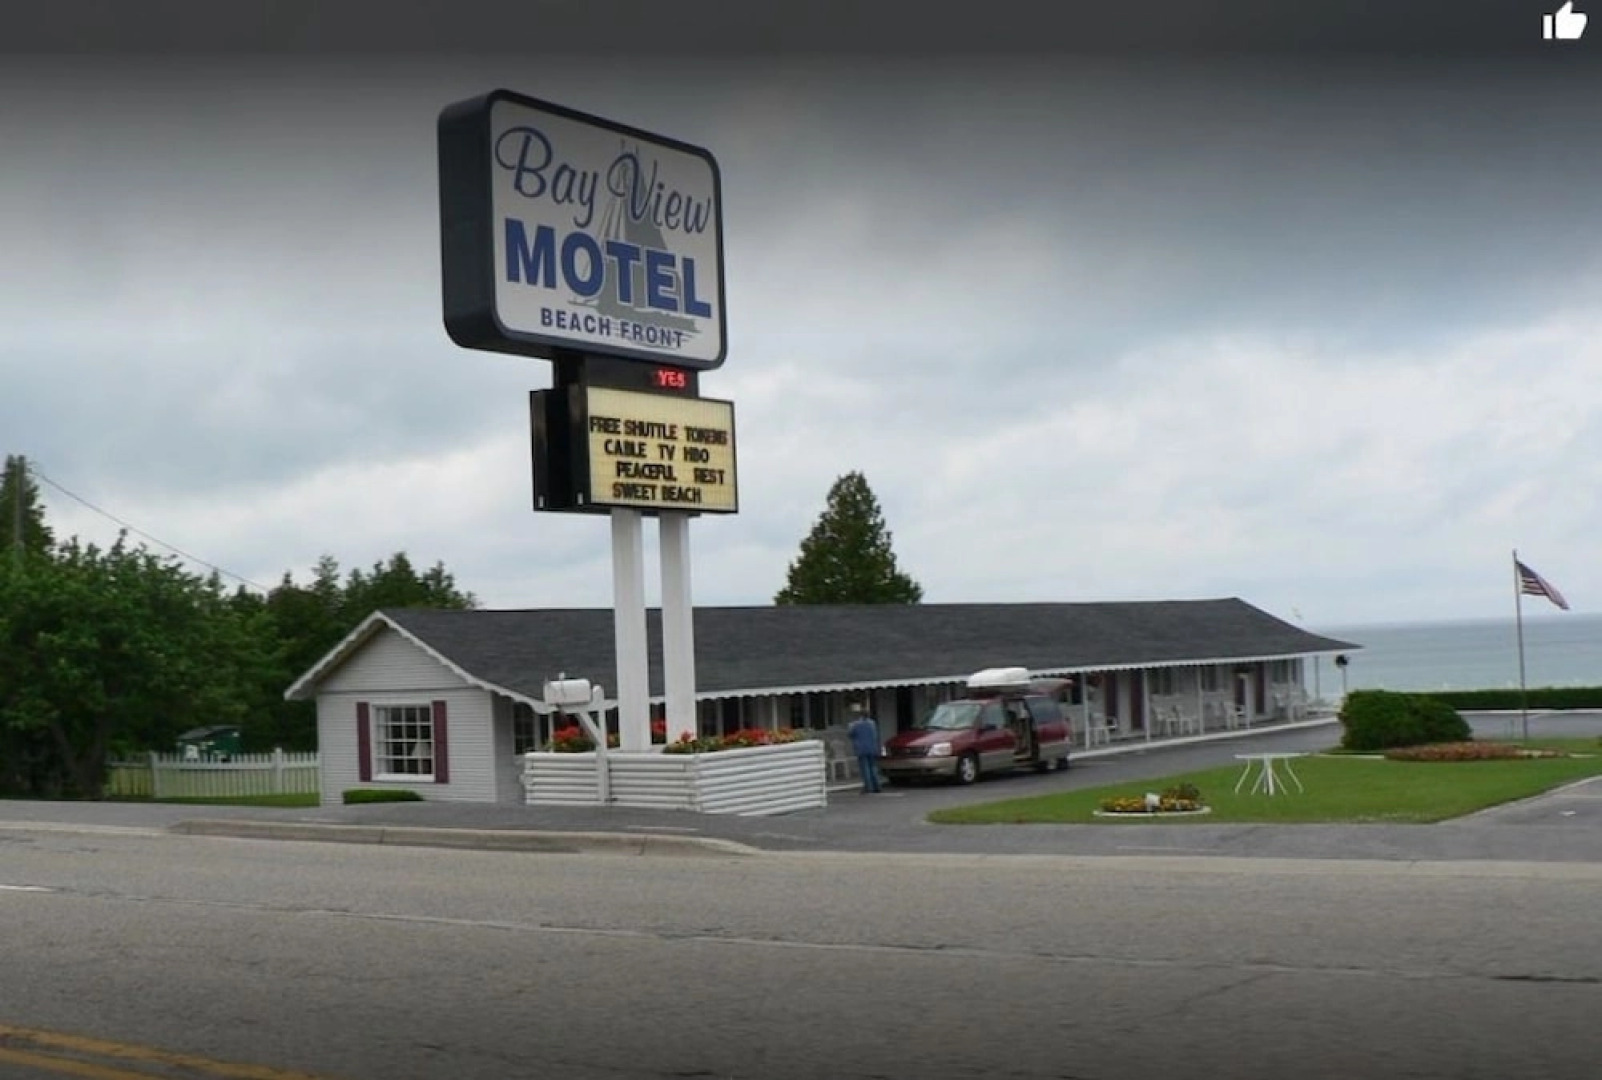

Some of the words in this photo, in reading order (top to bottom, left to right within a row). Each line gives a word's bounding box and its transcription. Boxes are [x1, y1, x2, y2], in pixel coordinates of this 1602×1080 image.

[495, 126, 599, 228] Bay
[607, 153, 711, 234] View
[504, 217, 712, 319] MOTEL
[540, 307, 611, 337] BEACH
[620, 322, 683, 348] FRONT
[658, 371, 685, 387] YES
[589, 416, 621, 434] FREE
[624, 420, 678, 440] SHUTTLE
[604, 439, 647, 458] CABLE
[658, 444, 675, 461] TV
[684, 446, 709, 463] HBO
[616, 461, 677, 481] PEACEFUL
[694, 467, 725, 485] REST
[612, 482, 658, 501] SWEET
[662, 485, 701, 503] BEACH
